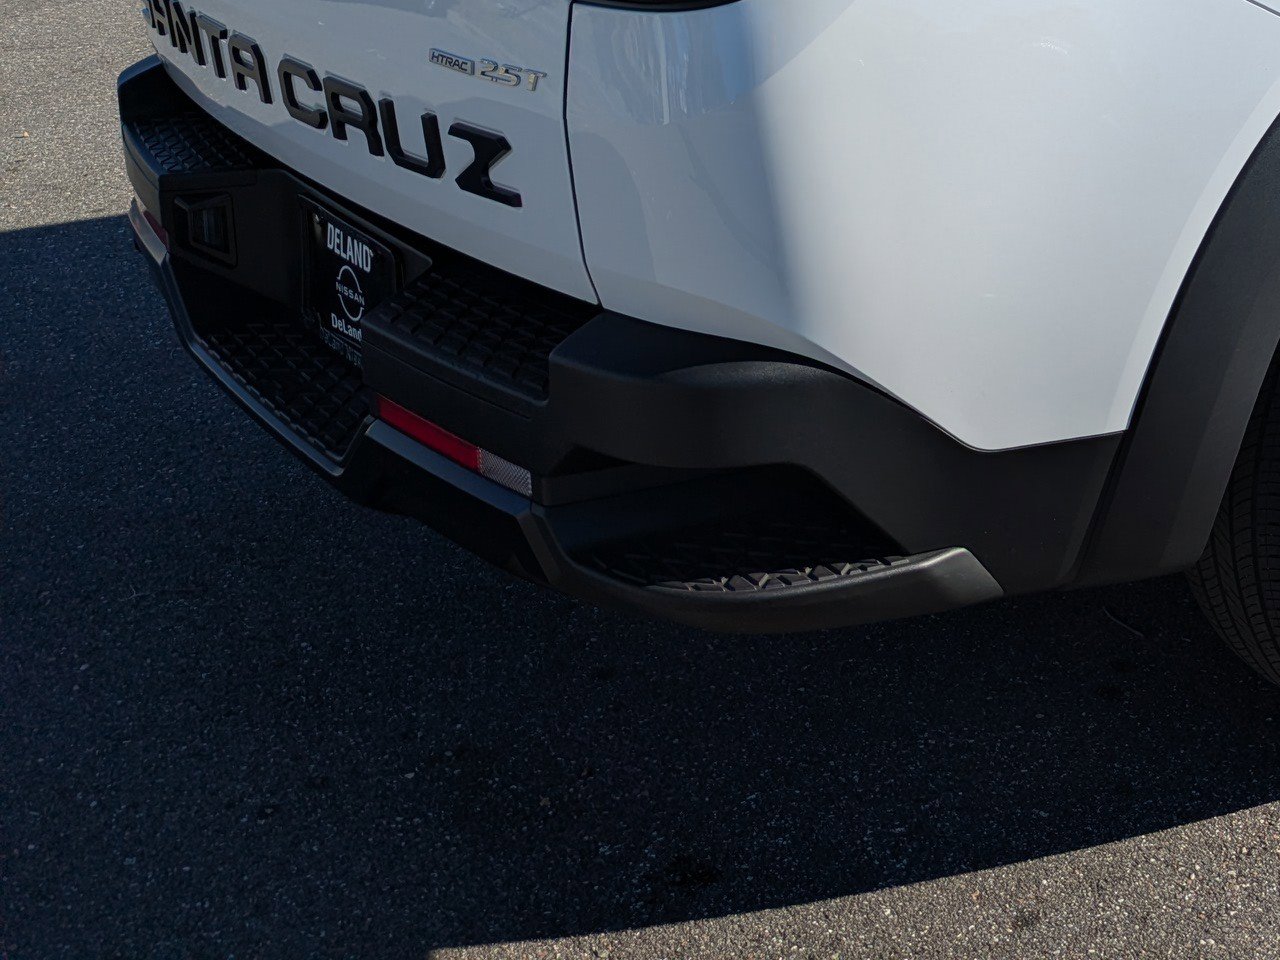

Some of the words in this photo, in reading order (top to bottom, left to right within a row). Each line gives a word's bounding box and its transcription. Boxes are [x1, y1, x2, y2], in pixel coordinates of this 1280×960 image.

[431, 51, 468, 72] HTRAC
[277, 53, 523, 208] CRUZ
[327, 222, 372, 274] DELAND
[335, 281, 366, 306] NISSAN
[331, 312, 362, 342] DeLand
